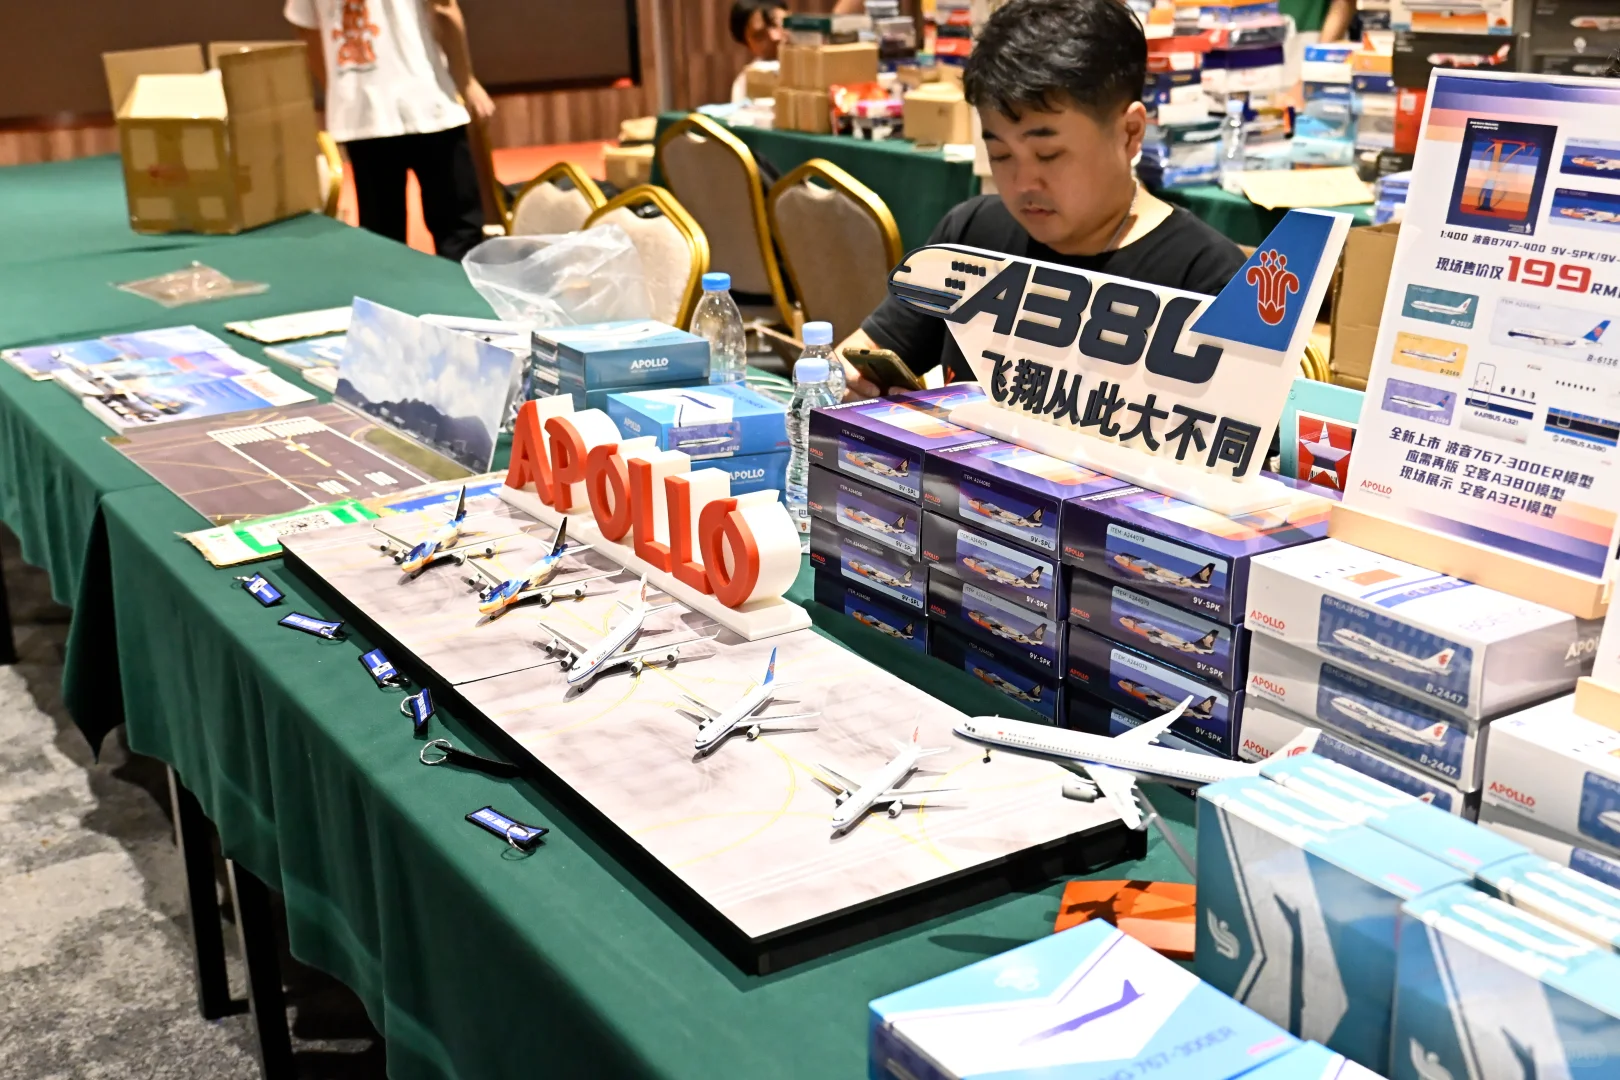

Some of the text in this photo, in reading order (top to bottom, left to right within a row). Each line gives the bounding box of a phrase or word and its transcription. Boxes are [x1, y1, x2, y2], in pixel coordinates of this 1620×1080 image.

[1440, 230, 1468, 242] 1:400
[1435, 256, 1620, 298] 现场售价仅 199 RM
[630, 357, 669, 370] APOLLO
[1587, 354, 1619, 366] B-6136
[981, 349, 1261, 478] 飞翔从此大不同
[1478, 412, 1501, 422] AIRBUS
[1389, 426, 1595, 490] 全新上市 波音767-300ER模型
[1405, 450, 1566, 502] 应需再版 空客A380模型
[1360, 480, 1392, 494] APOLLO
[1399, 465, 1557, 520] 现场展示 空客A321模型
[505, 399, 760, 608] APOLLO
[1030, 535, 1052, 549] 9V-SPL
[1064, 546, 1085, 559] APOLLO
[1193, 596, 1221, 612] 9V-SPK
[1071, 607, 1091, 620] APOLLO
[1250, 610, 1286, 630] APOLLO
[1030, 652, 1052, 667] 9V-SPK
[1070, 668, 1090, 682] APOLLO
[1196, 662, 1224, 679] 9V-SPK
[1252, 676, 1286, 696] APOLLO
[1426, 683, 1464, 704] B-2447
[1196, 726, 1222, 743] 9V-SPK
[1420, 754, 1457, 776] B-2447
[1488, 780, 1536, 807] APOLLO
